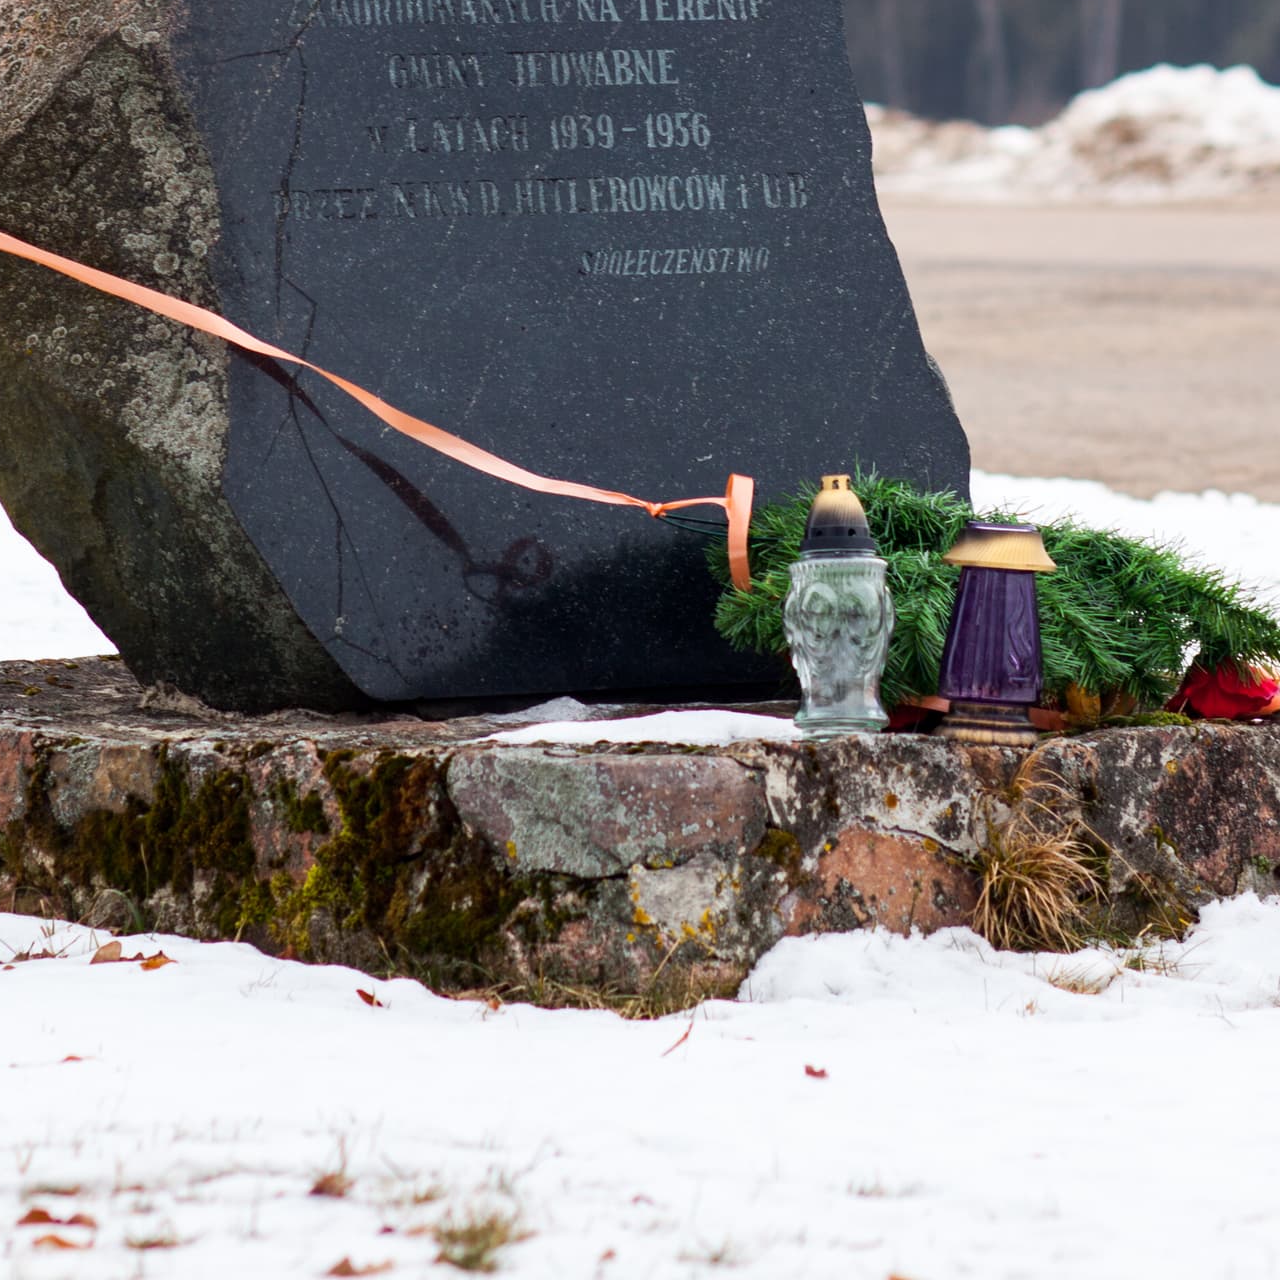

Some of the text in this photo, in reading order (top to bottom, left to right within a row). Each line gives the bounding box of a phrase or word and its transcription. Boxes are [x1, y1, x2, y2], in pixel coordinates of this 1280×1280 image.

[388, 48, 680, 90] GMINY JEDWABNE
[405, 115, 531, 153] LATACH
[271, 188, 378, 221] PRZEZ
